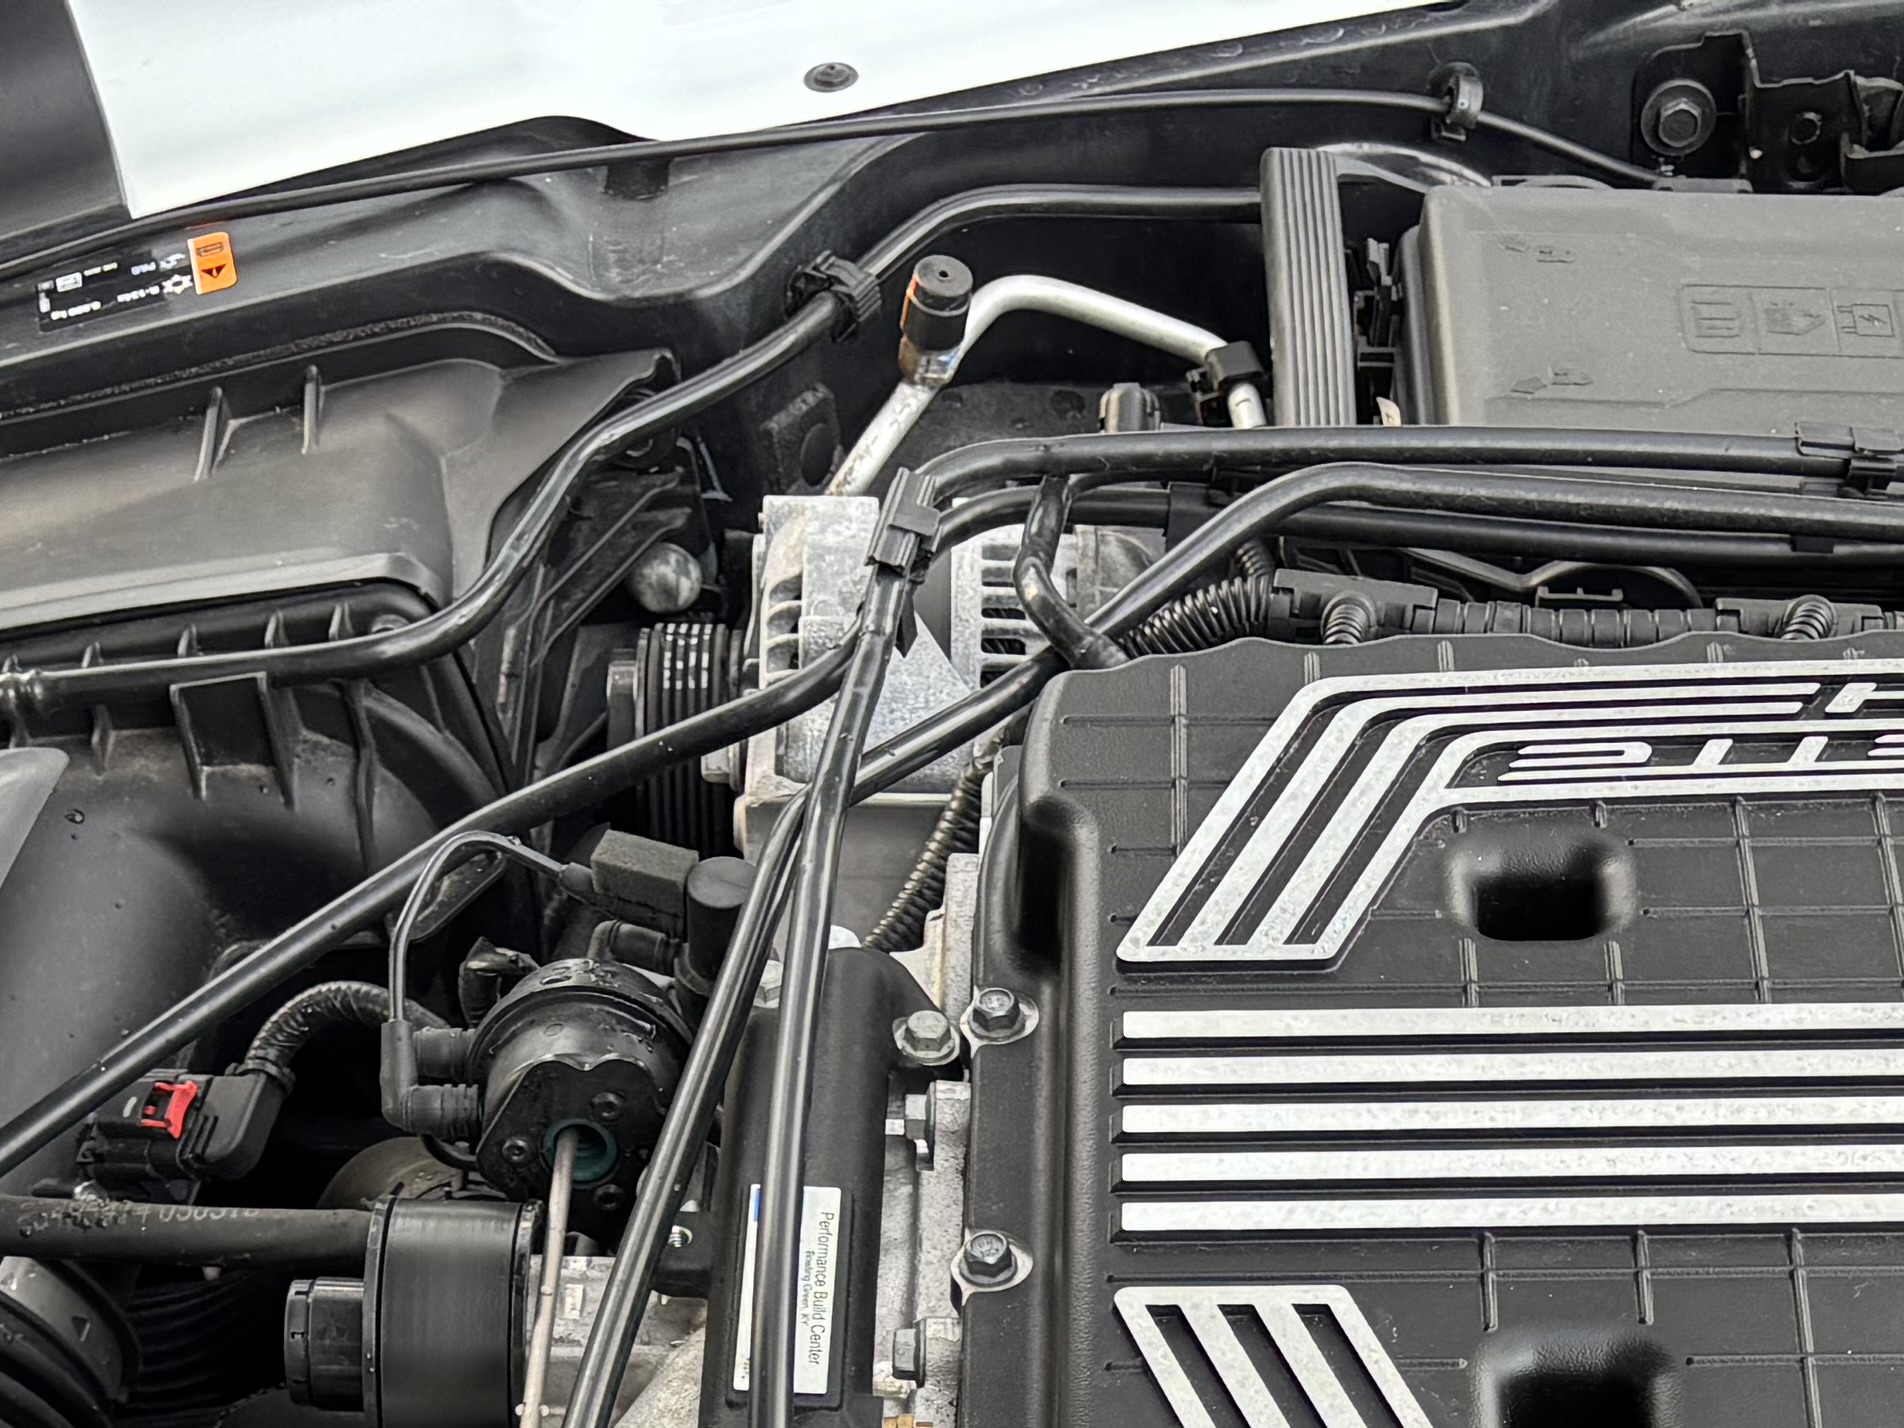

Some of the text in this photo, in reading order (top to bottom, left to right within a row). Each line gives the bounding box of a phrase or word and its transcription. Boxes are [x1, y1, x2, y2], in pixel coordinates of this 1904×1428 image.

[808, 1211, 835, 1366] Performance Build Center
